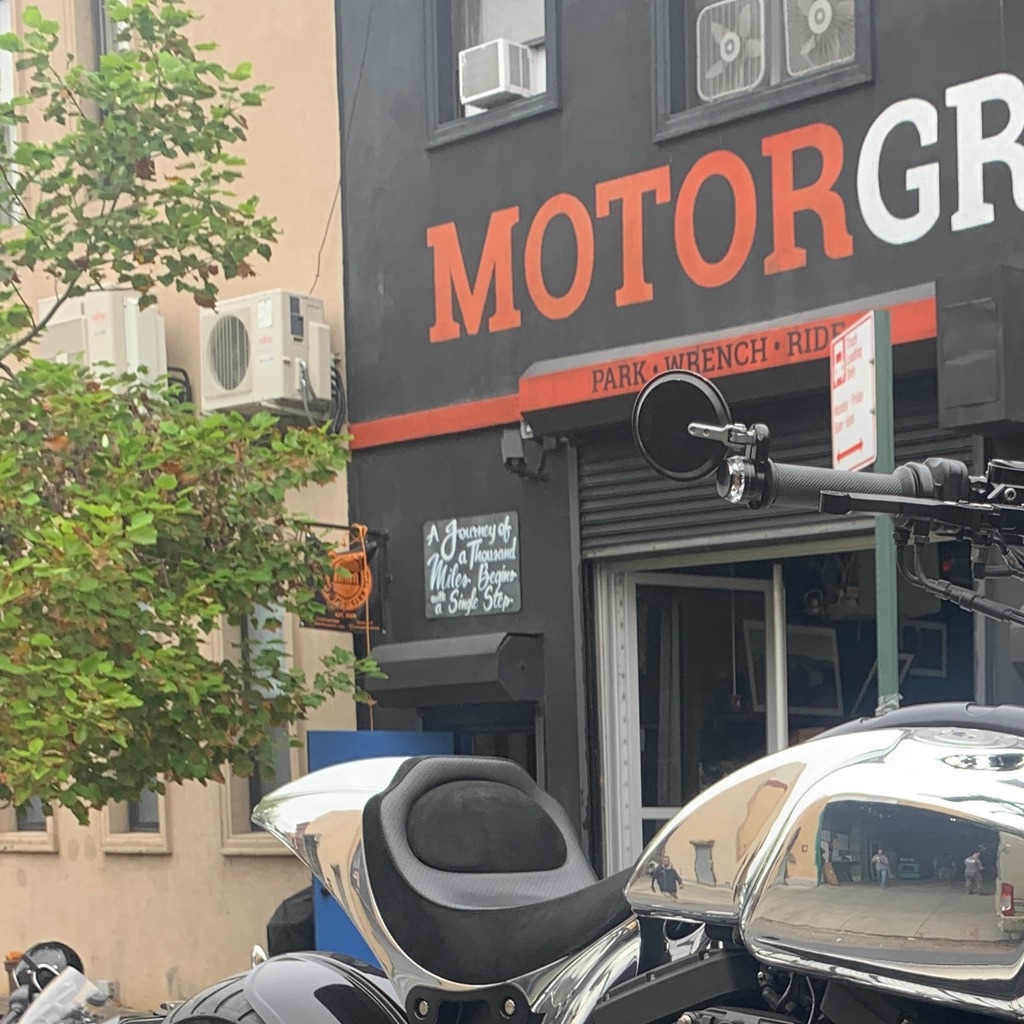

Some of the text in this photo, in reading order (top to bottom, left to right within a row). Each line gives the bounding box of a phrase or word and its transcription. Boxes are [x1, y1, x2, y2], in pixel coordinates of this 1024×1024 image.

[591, 322, 845, 394] PARK WRENCH RIDE
[426, 515, 512, 561] A Journey of
[459, 536, 517, 570] a Thousand
[427, 553, 517, 592] Miles Begins
[434, 585, 513, 616] a Single Step
